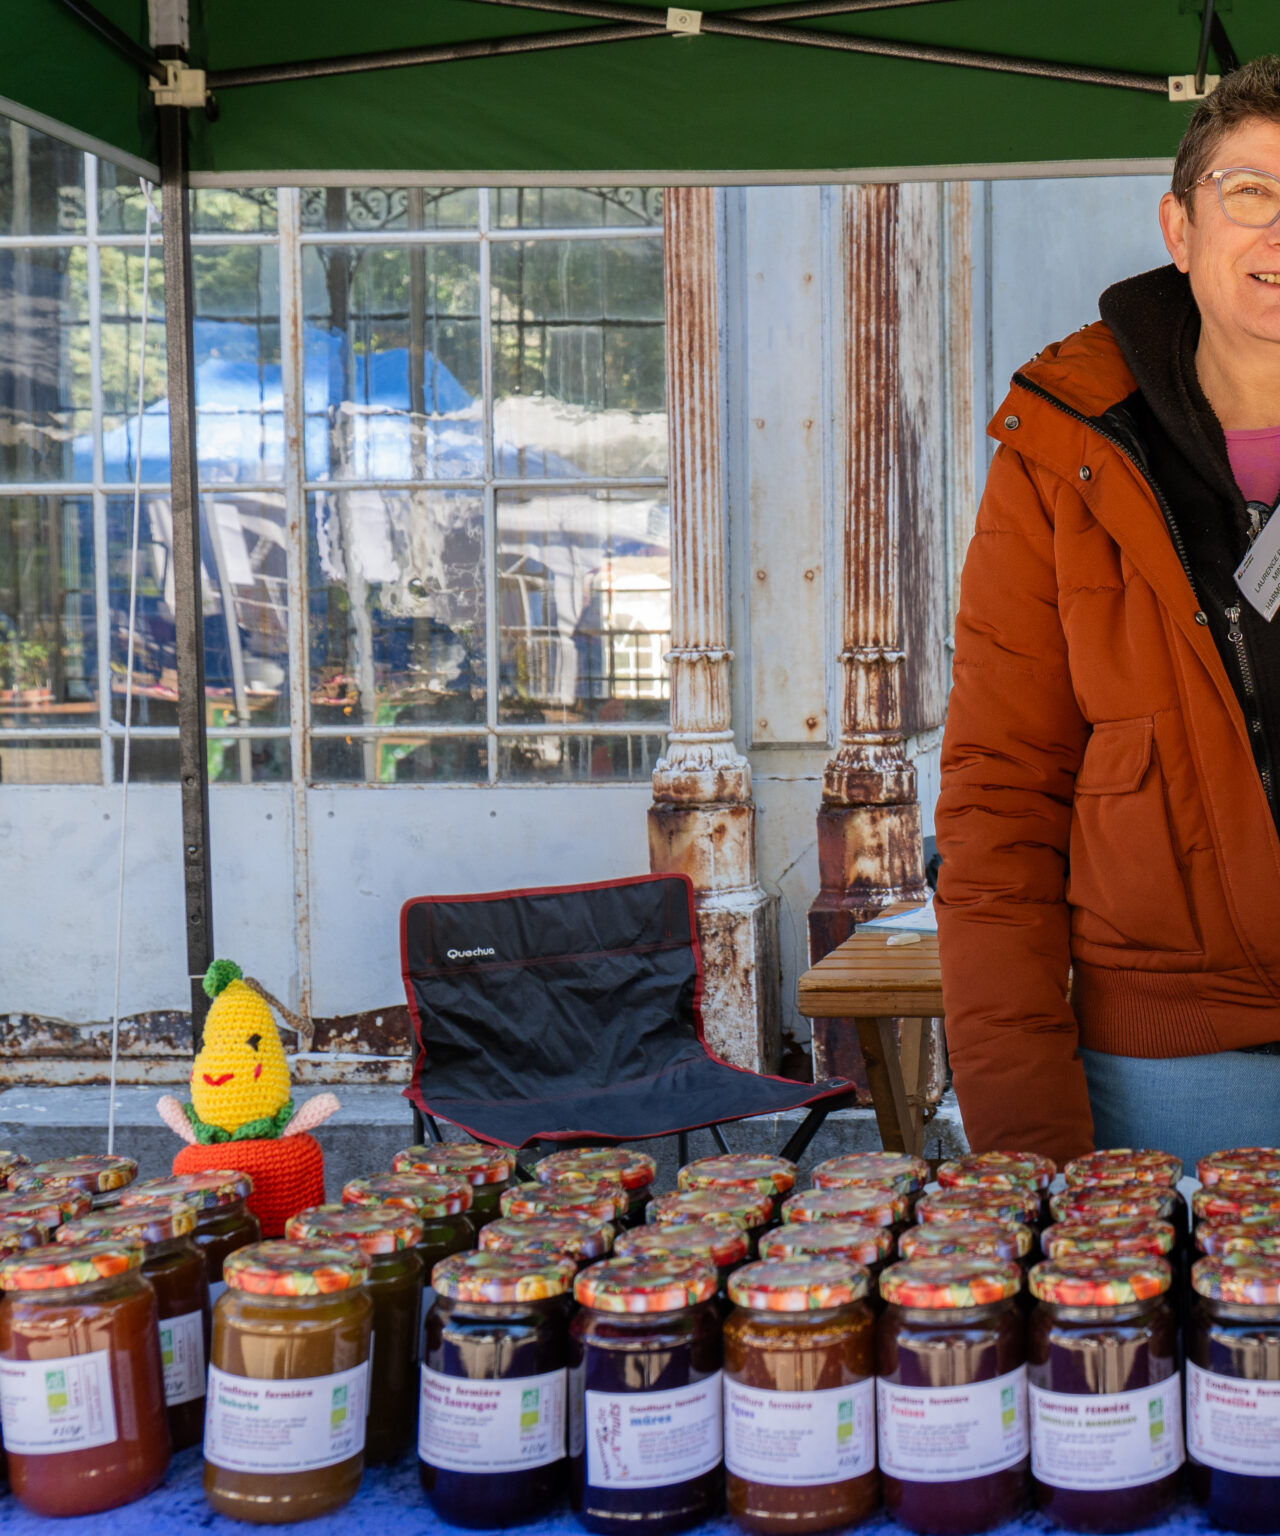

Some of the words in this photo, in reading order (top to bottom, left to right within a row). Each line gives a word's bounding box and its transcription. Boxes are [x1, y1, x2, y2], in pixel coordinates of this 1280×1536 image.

[1255, 555, 1278, 593] LAURENCE
[447, 946, 495, 959] Quechua
[219, 1382, 259, 1398] Confiture
[265, 1388, 313, 1400] fermière
[456, 1386, 501, 1397] fermière
[1205, 1378, 1250, 1395] Confiture
[768, 1400, 812, 1410] fermière
[929, 1396, 969, 1406] fermière
[629, 1404, 671, 1413] Confiture
